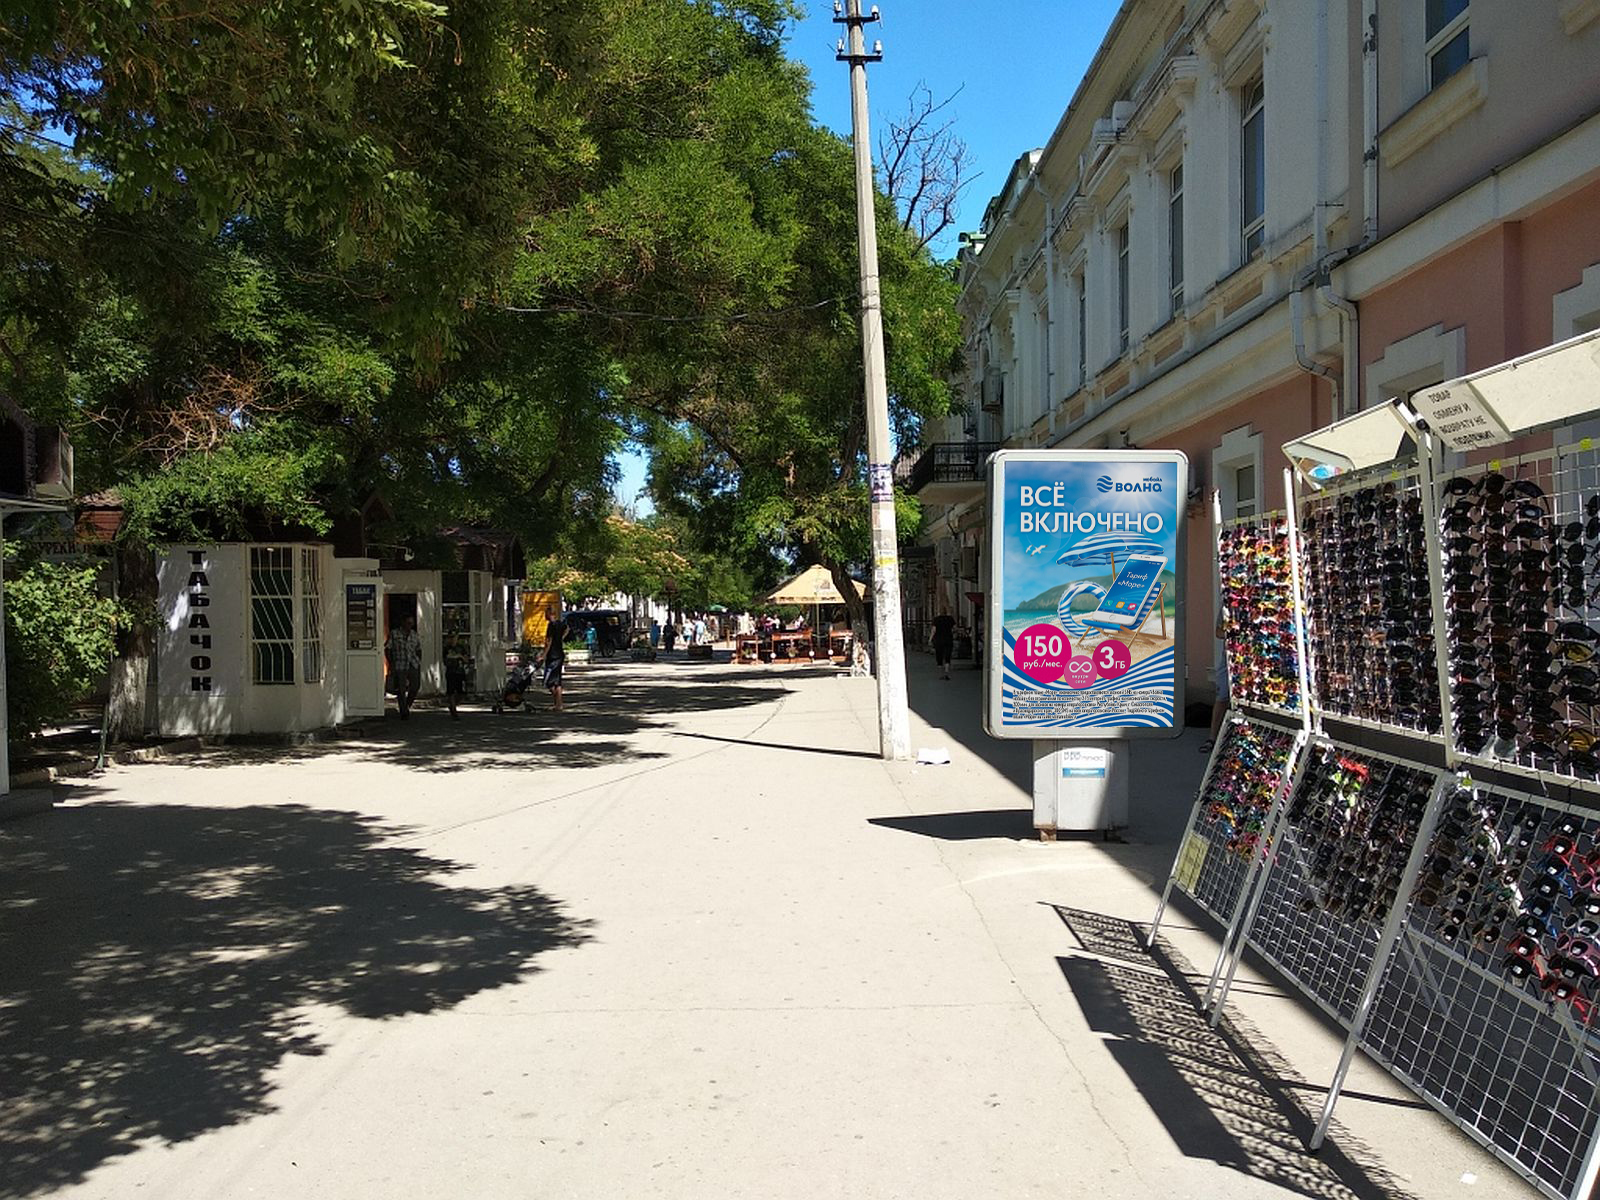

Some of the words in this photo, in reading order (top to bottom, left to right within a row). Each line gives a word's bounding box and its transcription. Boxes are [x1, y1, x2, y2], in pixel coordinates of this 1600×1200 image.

[1428, 389, 1451, 404] ТОВАР
[1432, 404, 1464, 420] ОБМЕНУ
[1462, 402, 1472, 412] И
[1439, 419, 1475, 435] ВОЗВРАТУ
[1474, 415, 1487, 426] НЕ
[1020, 481, 1065, 507] ВСЁ
[1020, 511, 1164, 534] ВКЛЮЧЕНО
[1126, 571, 1148, 582] Тариф
[187, 550, 212, 692] ТАБАЧОК
[1024, 635, 1063, 657] 150
[1023, 659, 1063, 670] руб./мес.
[1099, 646, 1115, 669] 3
[1115, 660, 1126, 669] ГБ
